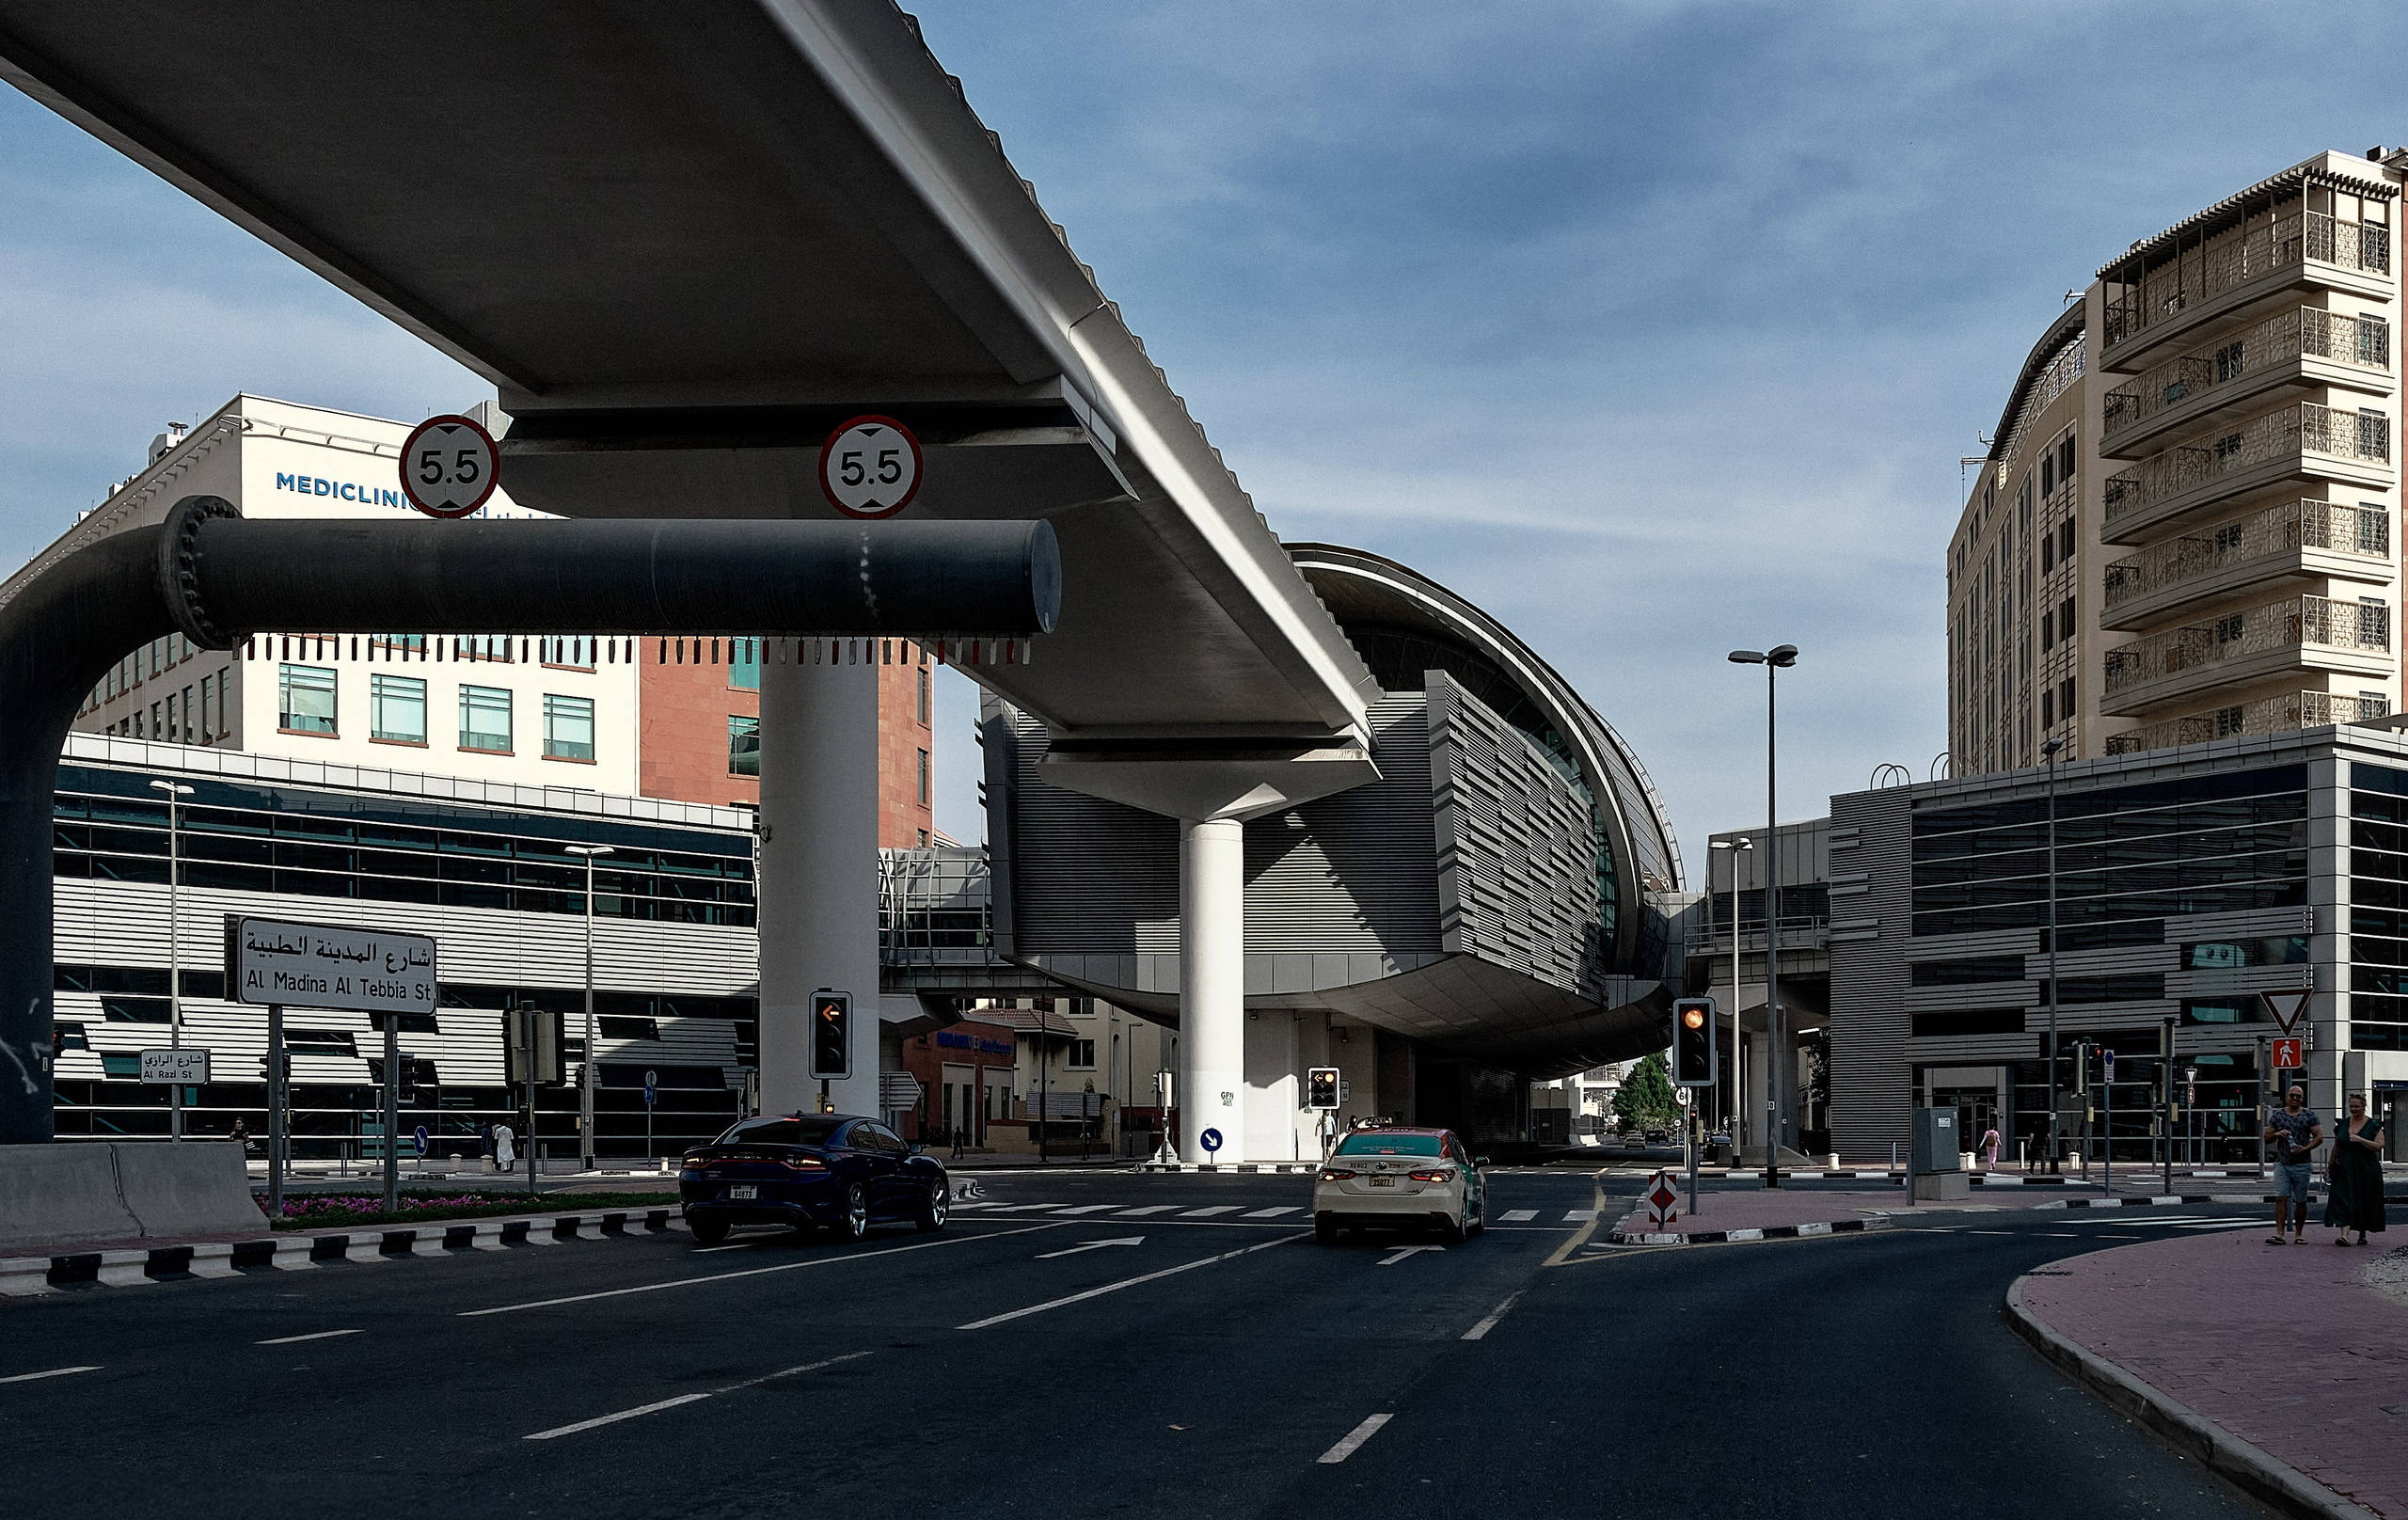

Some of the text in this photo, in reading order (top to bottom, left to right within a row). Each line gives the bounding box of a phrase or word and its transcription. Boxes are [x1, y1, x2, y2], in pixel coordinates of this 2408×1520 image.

[419, 449, 480, 485] 5.5
[841, 450, 901, 485] 5.5
[276, 471, 420, 513] MEDICLINI
[246, 930, 431, 974] شارع المدينة الطبية
[246, 969, 432, 1002] Al Madina Al Tebbia St
[143, 1069, 193, 1079] Al Razi St
[144, 1054, 203, 1068] شارع الرازي
